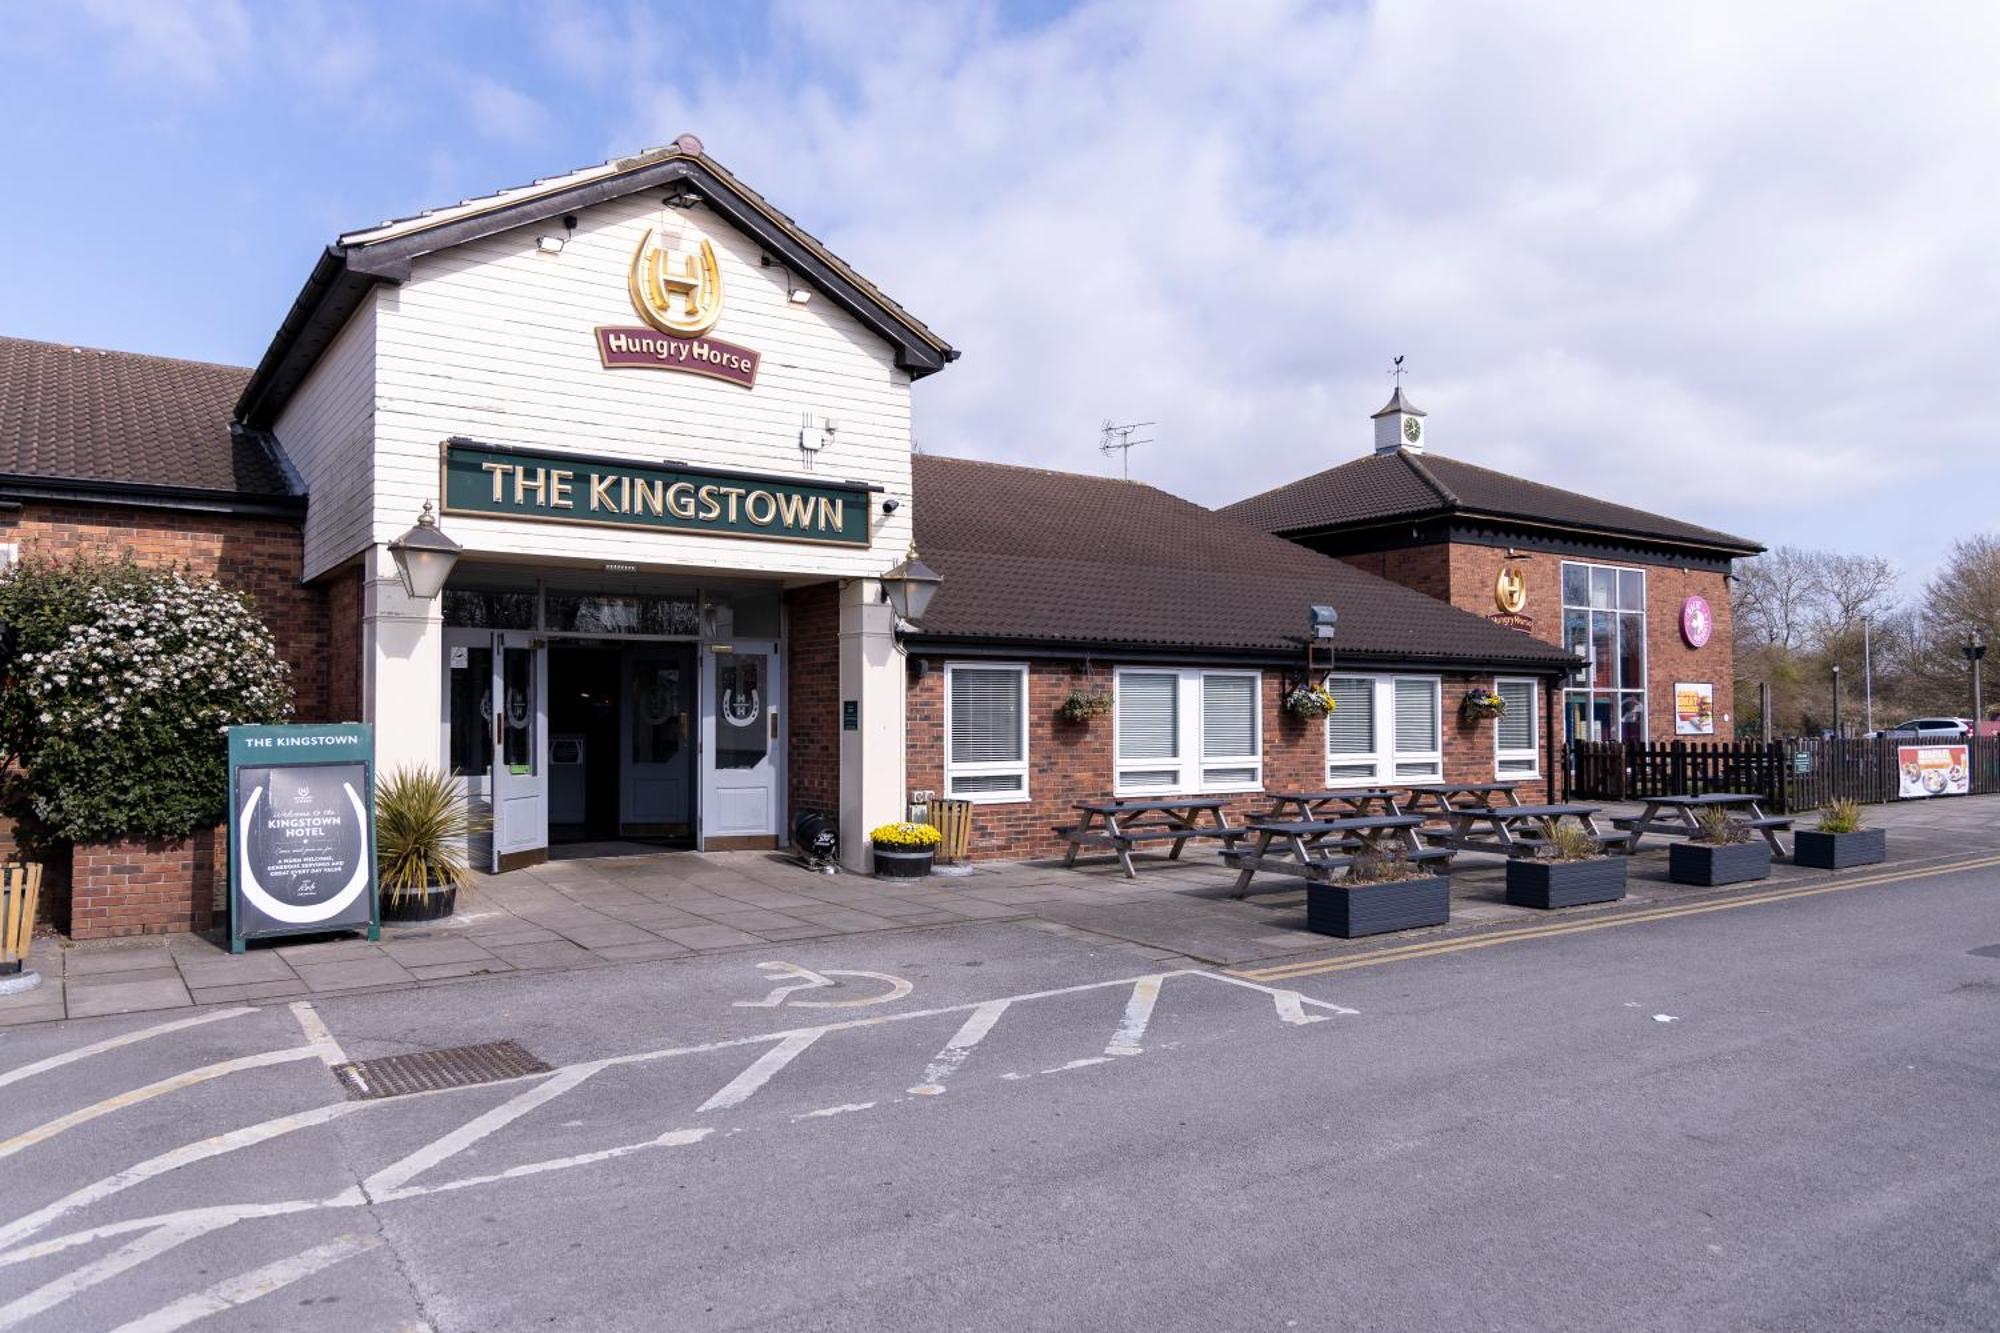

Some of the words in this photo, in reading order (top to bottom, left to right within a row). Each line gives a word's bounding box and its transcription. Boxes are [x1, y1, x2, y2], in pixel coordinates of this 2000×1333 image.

[482, 462, 575, 509] THE
[590, 472, 844, 533] KINGSTOWN
[245, 738, 273, 748] THE
[276, 735, 358, 747] KINGSTOWN
[268, 816, 341, 829] KINGSTOWN
[286, 827, 325, 838] HOTEL
